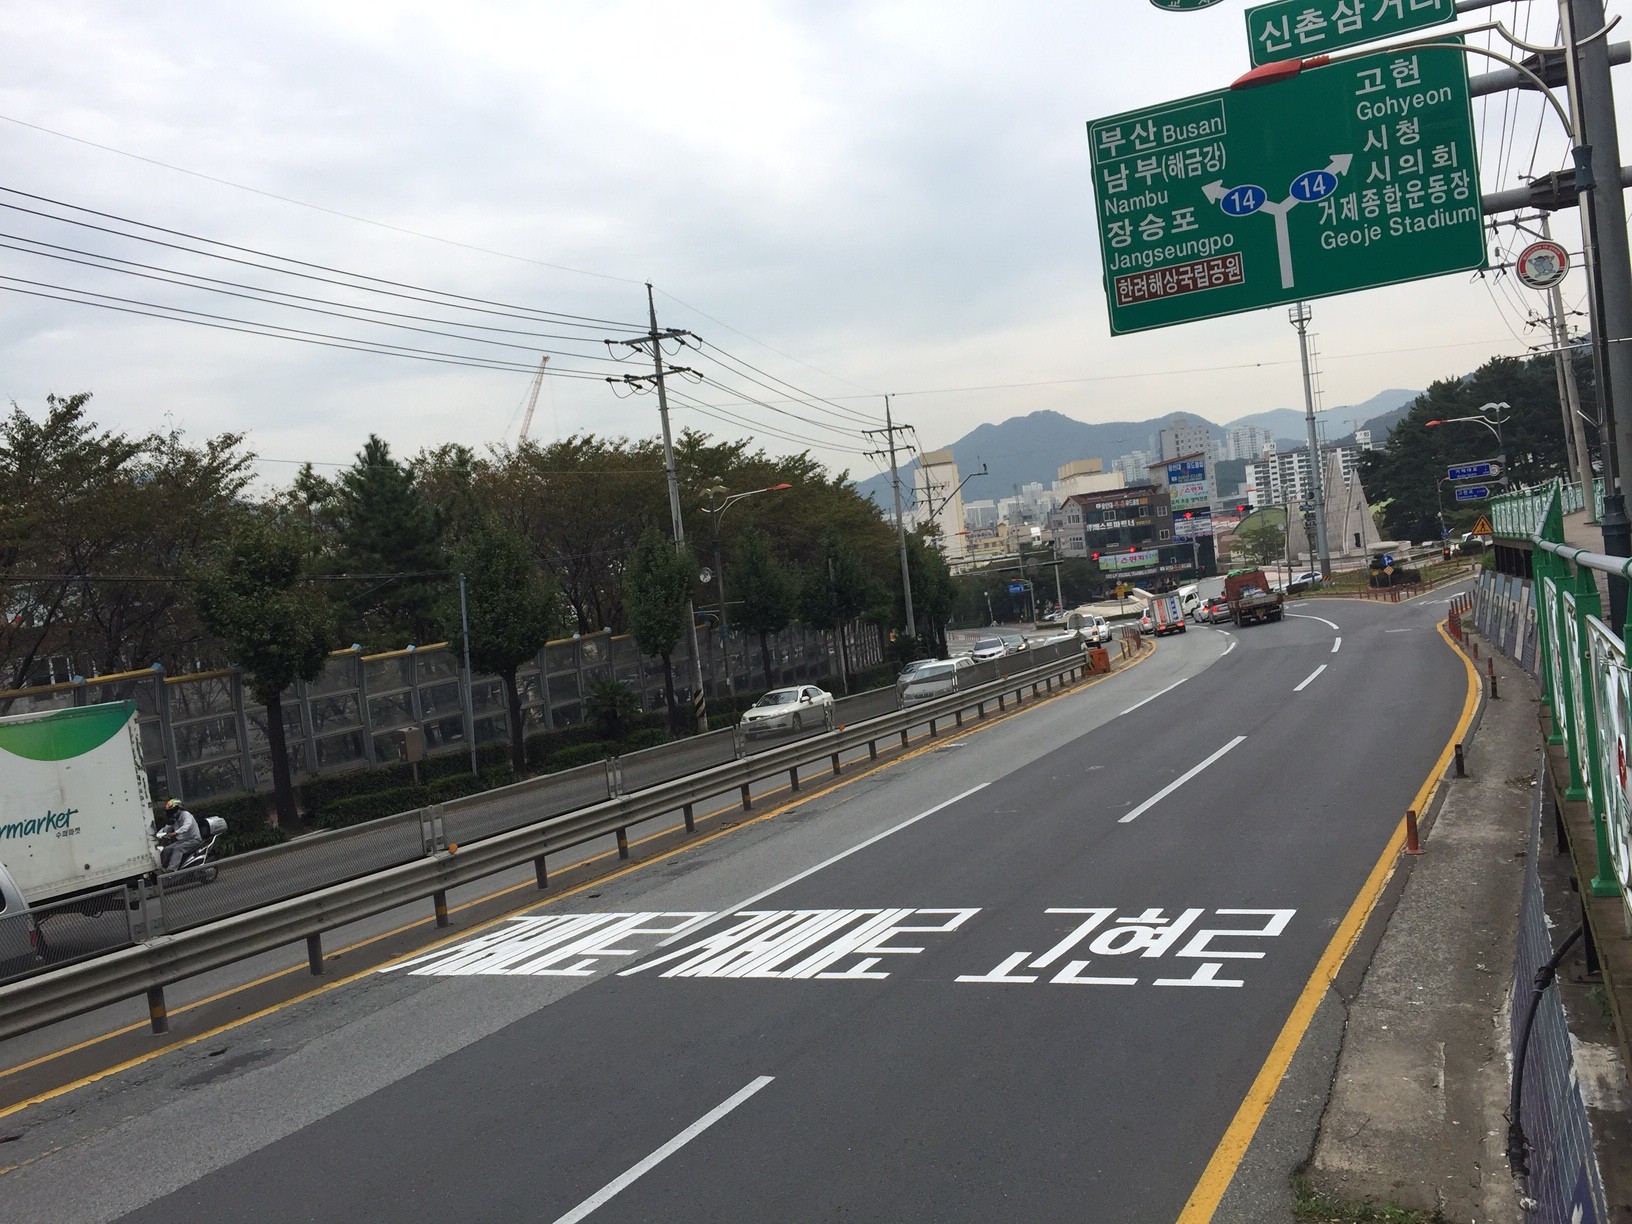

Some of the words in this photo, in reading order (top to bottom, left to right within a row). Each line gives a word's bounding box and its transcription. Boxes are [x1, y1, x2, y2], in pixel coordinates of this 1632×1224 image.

[1354, 55, 1422, 96] 고현
[1356, 85, 1452, 121] Gohyeon
[1099, 122, 1158, 158] 부산
[1162, 115, 1223, 143] Busan
[1362, 117, 1421, 152] 시청
[1366, 142, 1459, 185] 시의회
[1105, 190, 1169, 216] Nambu
[1231, 190, 1256, 212] 14
[1302, 175, 1327, 198] 14
[1318, 168, 1471, 226] 거제종합운동장
[1107, 206, 1199, 248] 장승포
[1320, 217, 1383, 250] Geoje
[1389, 205, 1477, 236] Stadium
[1110, 233, 1234, 270] Jangseungpo
[1117, 256, 1242, 302] 한려해상국립공원
[954, 907, 1298, 988] 고현로
